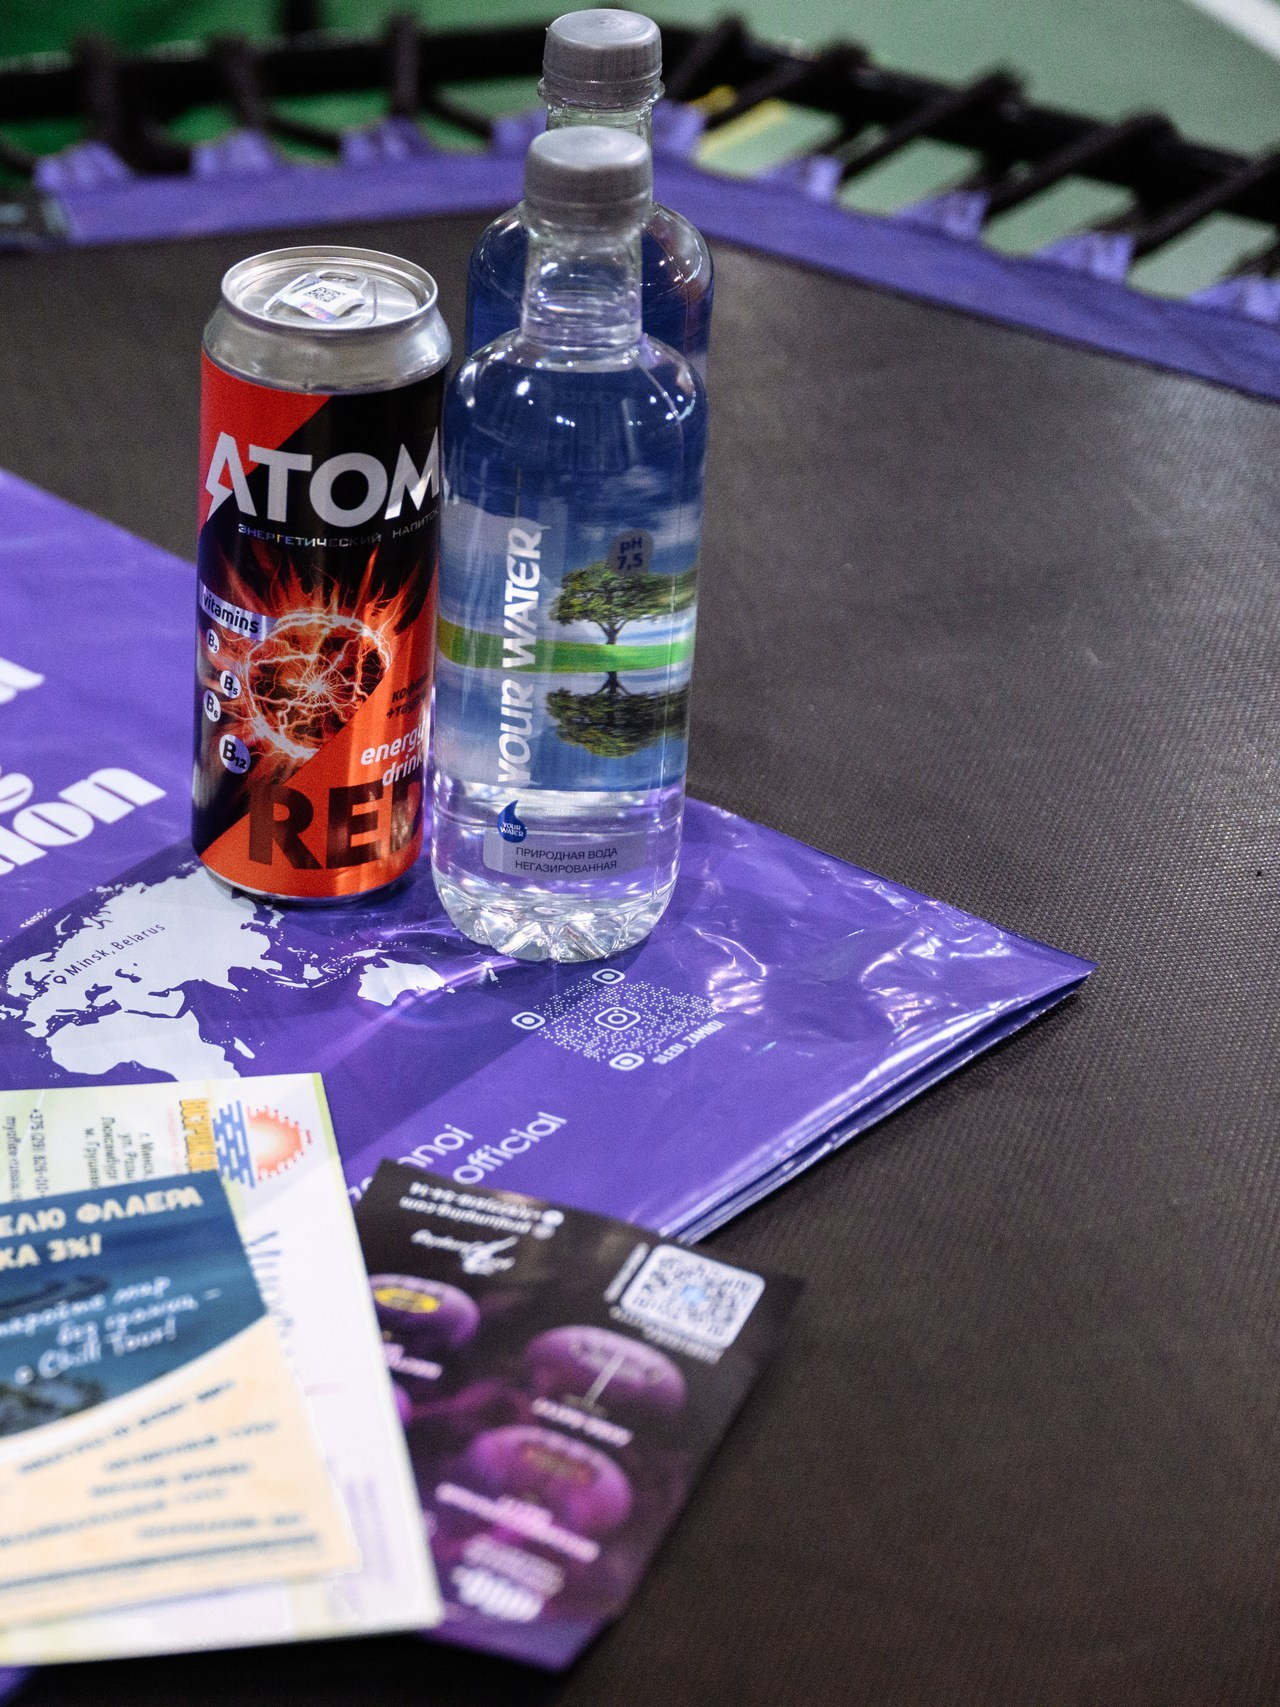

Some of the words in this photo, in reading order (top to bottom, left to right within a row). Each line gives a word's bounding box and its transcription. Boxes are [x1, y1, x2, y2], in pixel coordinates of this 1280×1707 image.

[205, 426, 440, 528] ATOM
[238, 523, 382, 548] ЭНЕРГЕТИЧЕСКИЙ
[203, 593, 260, 634] vitamins
[502, 526, 546, 670] WATER
[224, 675, 238, 695] B5
[361, 721, 425, 765] energy
[498, 678, 535, 786] YOUR
[223, 740, 247, 770] B12
[500, 826, 524, 838] WATER
[503, 821, 521, 831] YOUR
[515, 860, 618, 873] НЕГАЗИРОВАННАЯ
[516, 846, 585, 861] ПРИРОДНАЯ
[588, 847, 618, 860] ВОДА
[64, 949, 116, 976] Minsk,
[110, 924, 166, 950] Belarus
[453, 1111, 568, 1184] official
[75, 1185, 204, 1225] ФЛАЕРА
